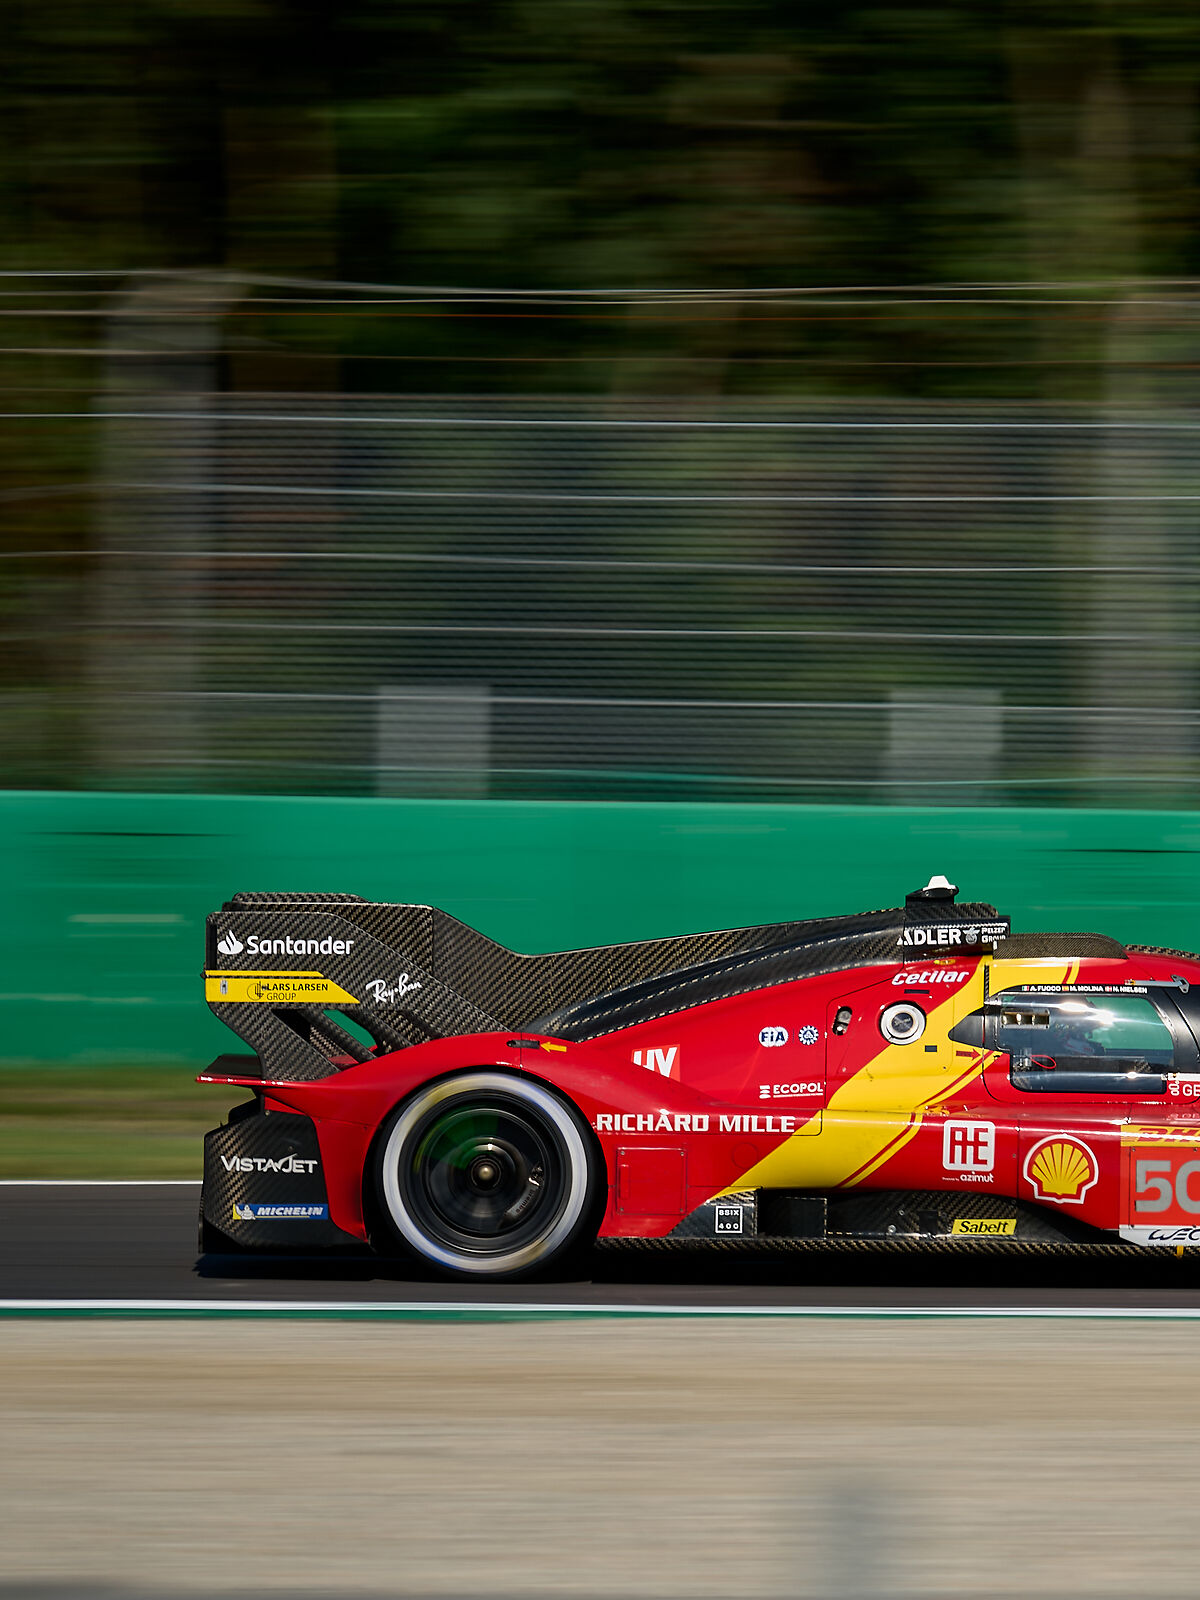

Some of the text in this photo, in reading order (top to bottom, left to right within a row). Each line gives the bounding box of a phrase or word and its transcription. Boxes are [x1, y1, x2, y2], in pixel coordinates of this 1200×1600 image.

[897, 928, 962, 946] ADLER
[246, 936, 354, 955] Santander
[891, 970, 970, 986] Cetilar
[266, 983, 328, 991] LARS LARSEN
[266, 992, 297, 1001] GROUP
[773, 1083, 823, 1095] ECOPOL
[719, 1115, 795, 1133] MILLE
[960, 1171, 994, 1183] azimut
[256, 1206, 323, 1216] MICHELIN
[959, 1220, 1009, 1234] Sabelt
